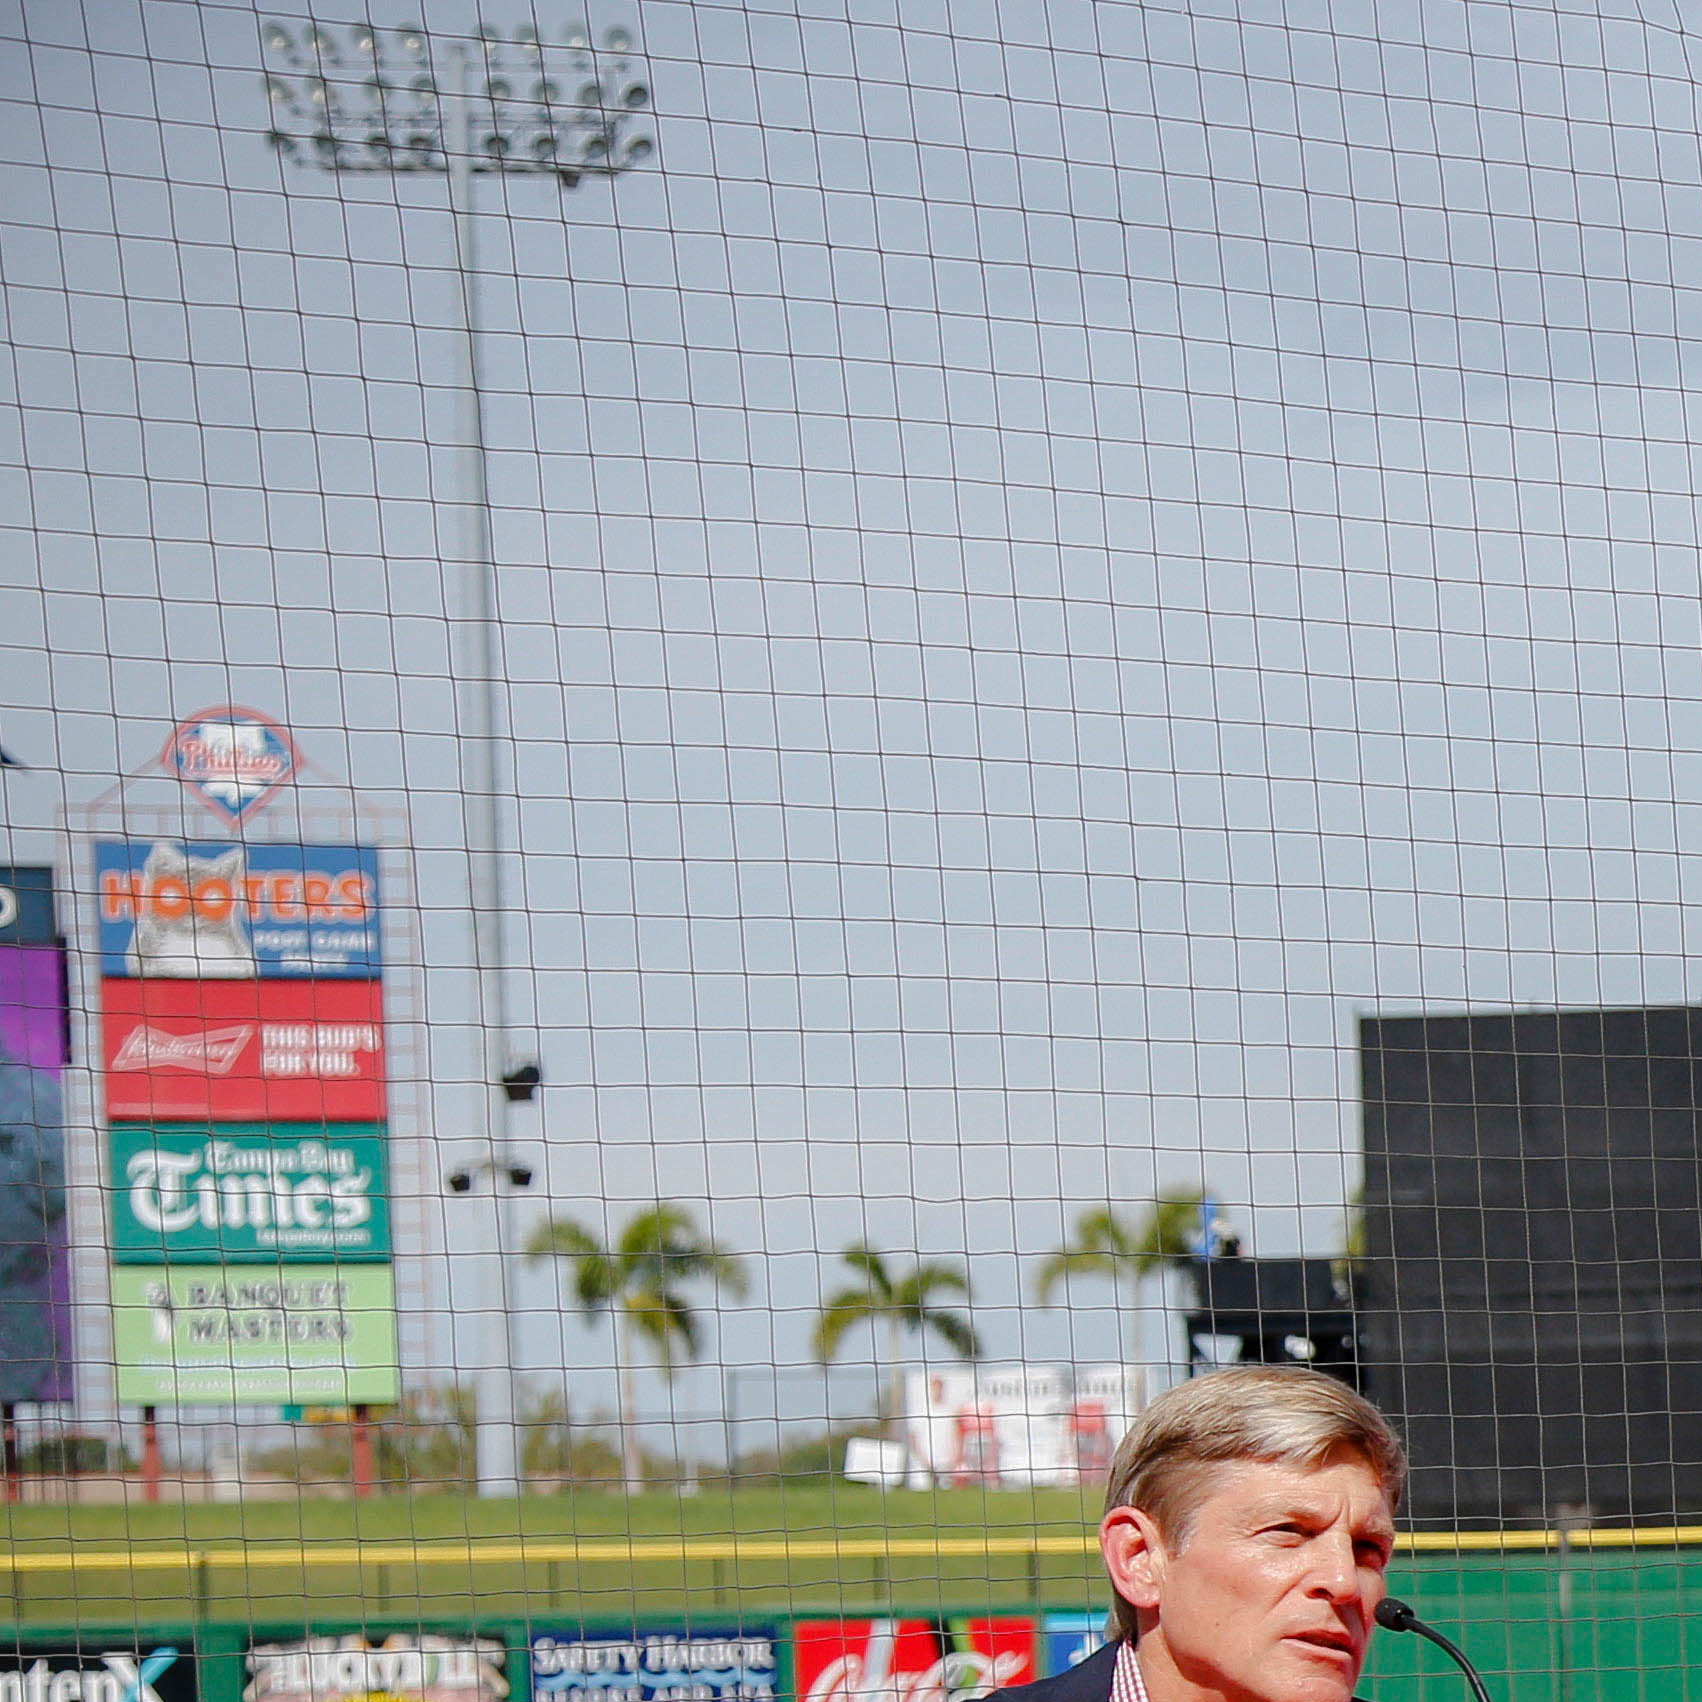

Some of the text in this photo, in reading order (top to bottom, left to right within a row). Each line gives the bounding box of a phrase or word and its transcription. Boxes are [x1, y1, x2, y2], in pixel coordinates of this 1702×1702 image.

[101, 870, 374, 922] HOOTERS
[205, 1141, 355, 1177] Tampa Bay
[127, 1149, 372, 1232] Times
[188, 1280, 350, 1307] BANQUET
[188, 1317, 350, 1342] MASTERS
[534, 1634, 777, 1675] SAFETY HARBOR
